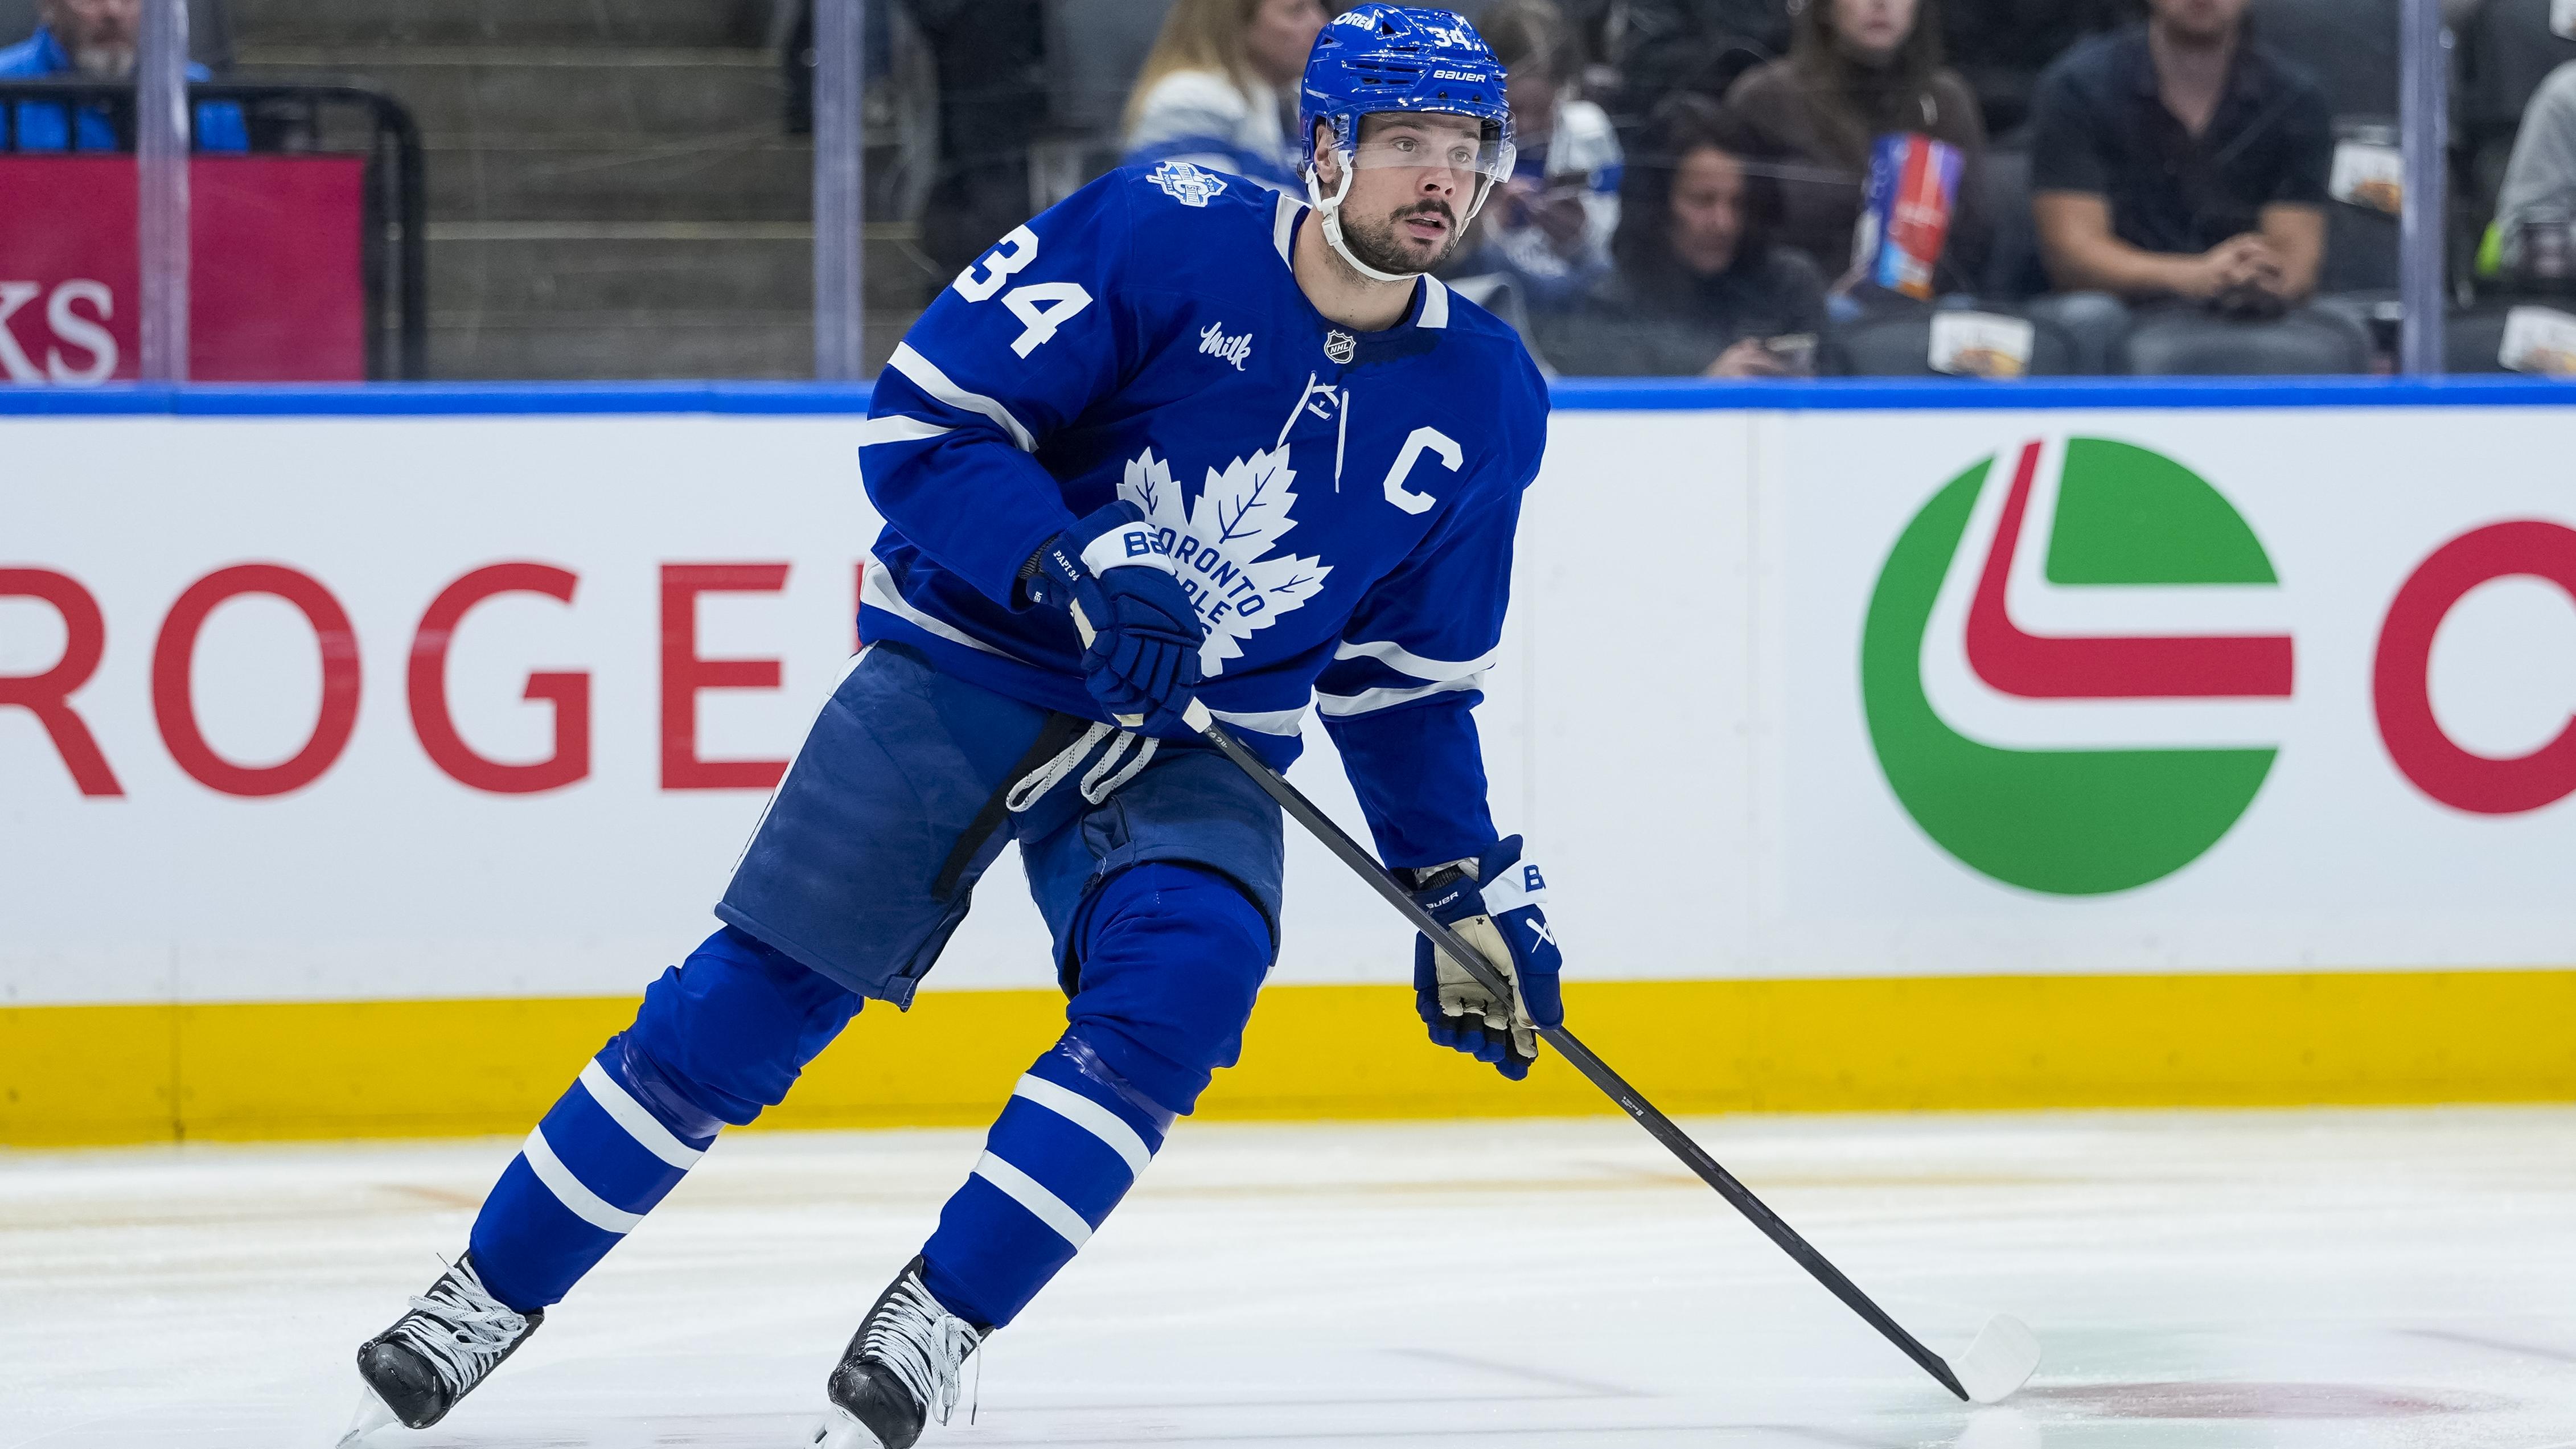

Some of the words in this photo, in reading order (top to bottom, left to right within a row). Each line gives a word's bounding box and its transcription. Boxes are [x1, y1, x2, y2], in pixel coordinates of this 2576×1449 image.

[1333, 9, 1376, 31] OREO
[1425, 27, 1472, 51] 34
[1433, 70, 1486, 83] BAUER
[952, 224, 1092, 359] 34
[1199, 321, 1252, 371] Milk
[1330, 343, 1349, 354] NHL
[1383, 426, 1464, 515] C
[1053, 550, 1073, 572] PAPI
[1149, 524, 1265, 617] ORONTO
[1033, 591, 1043, 603] ER
[1175, 572, 1232, 625] PLE
[0, 563, 863, 798] ROGE
[1426, 891, 1458, 909] AUER
